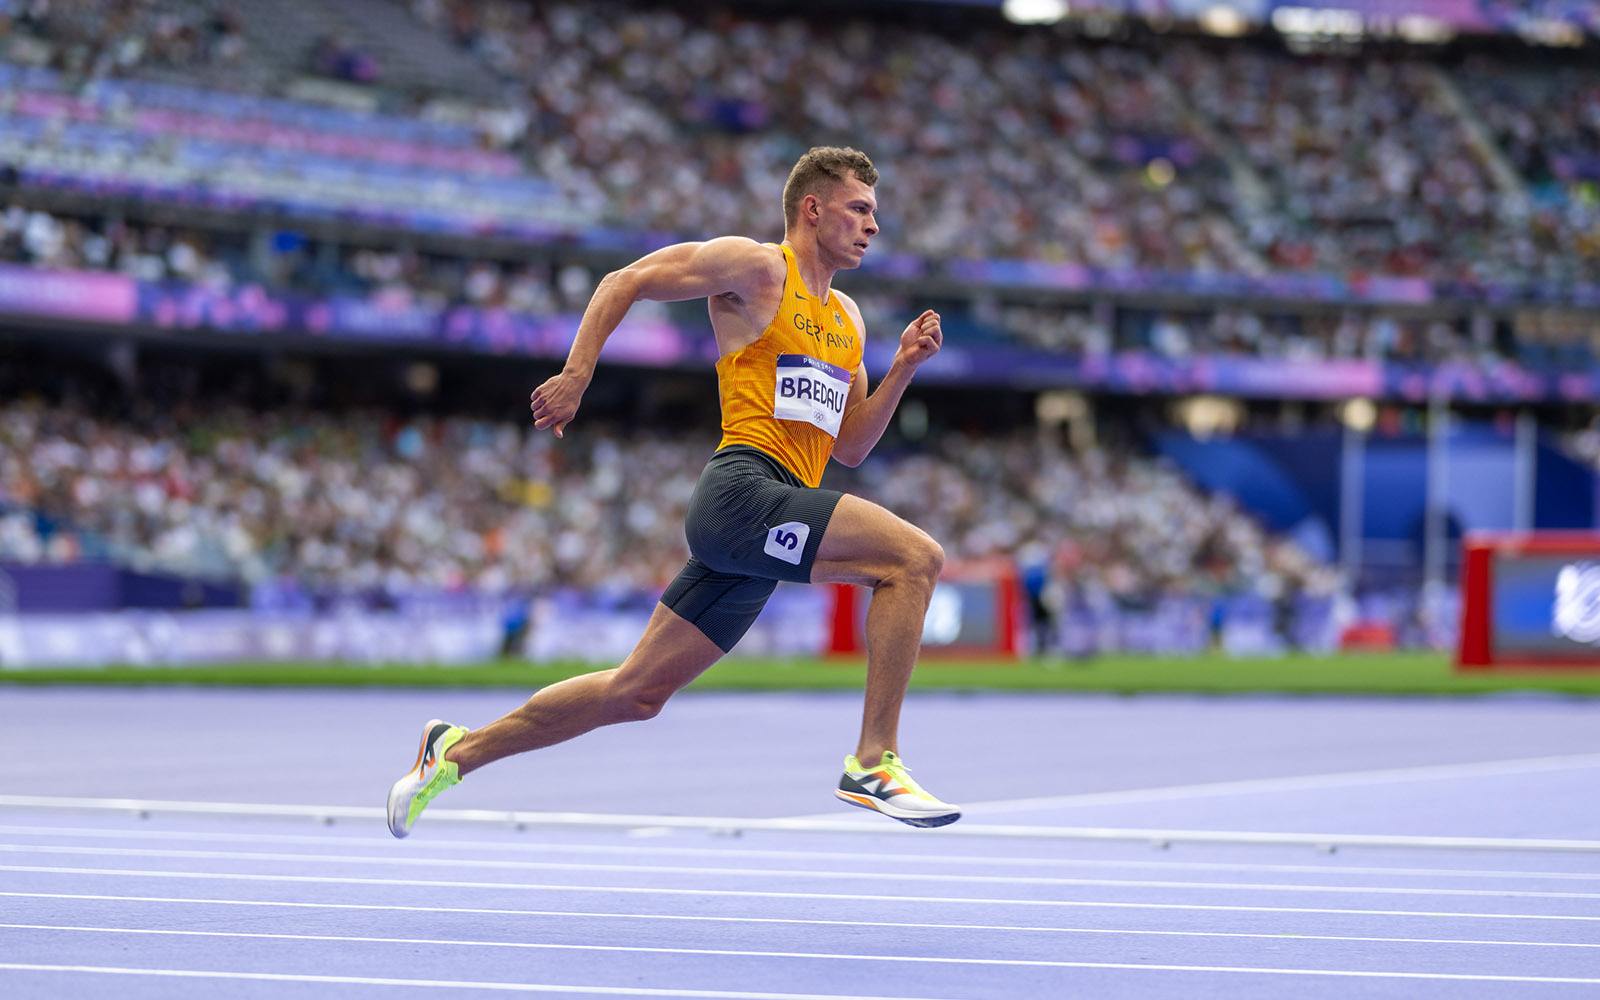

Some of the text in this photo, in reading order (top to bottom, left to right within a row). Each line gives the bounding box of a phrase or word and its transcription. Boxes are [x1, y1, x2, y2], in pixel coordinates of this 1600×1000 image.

[793, 313, 854, 350] GERANY
[780, 376, 844, 413] BREDAU
[774, 529, 799, 550] 5
